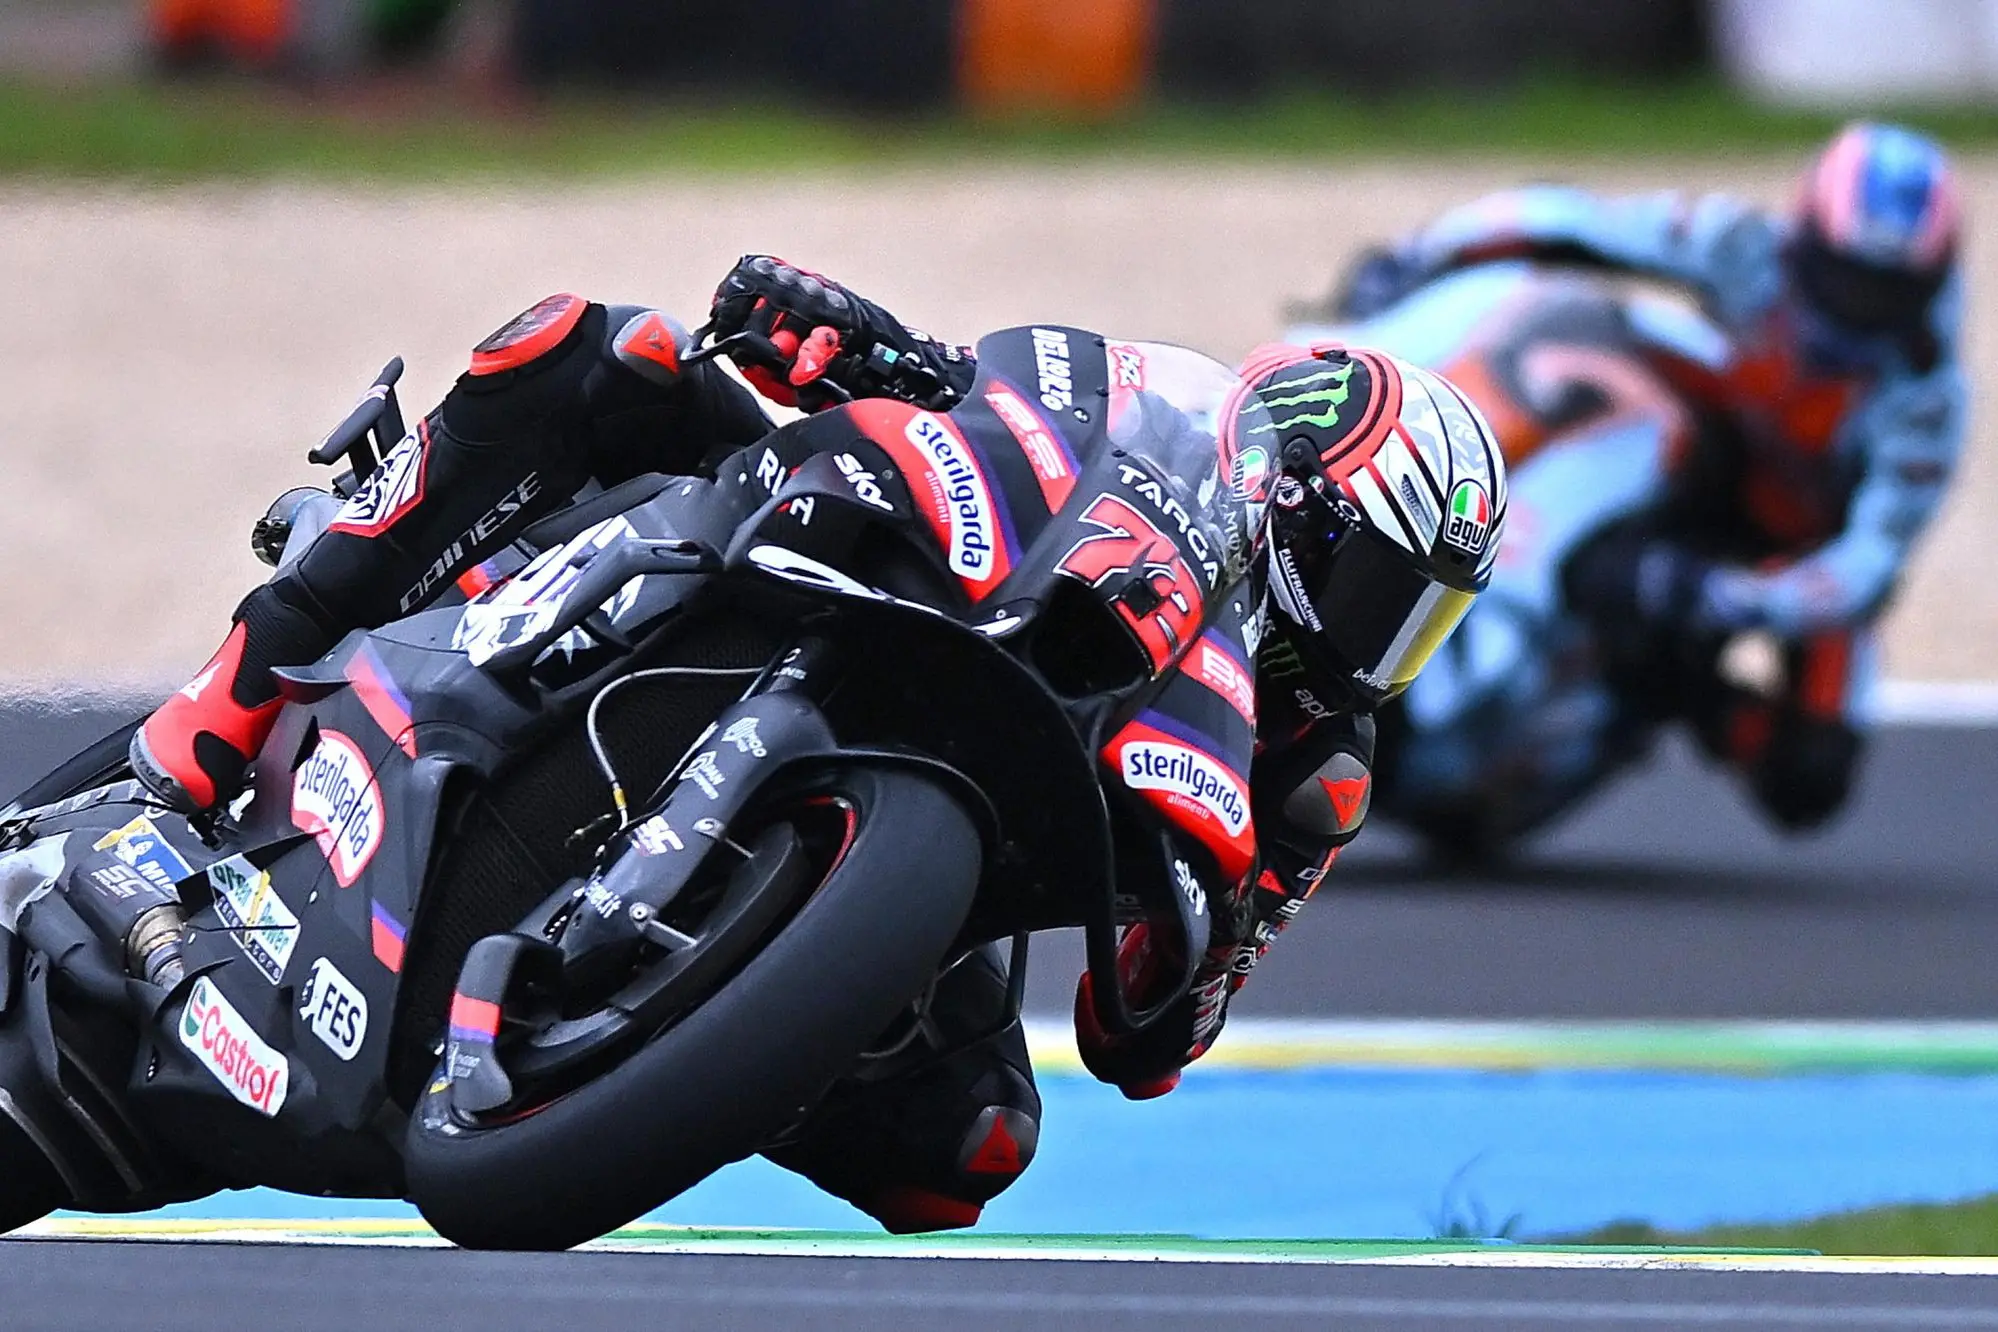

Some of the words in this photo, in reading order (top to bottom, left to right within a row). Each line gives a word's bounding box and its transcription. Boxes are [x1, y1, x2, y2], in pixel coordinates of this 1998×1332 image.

[833, 453, 894, 512] sky
[916, 422, 990, 568] sterilgarda
[1117, 464, 1218, 591] TARGA
[1130, 748, 1243, 825] sterilgarda
[202, 1005, 281, 1113] Castrol
